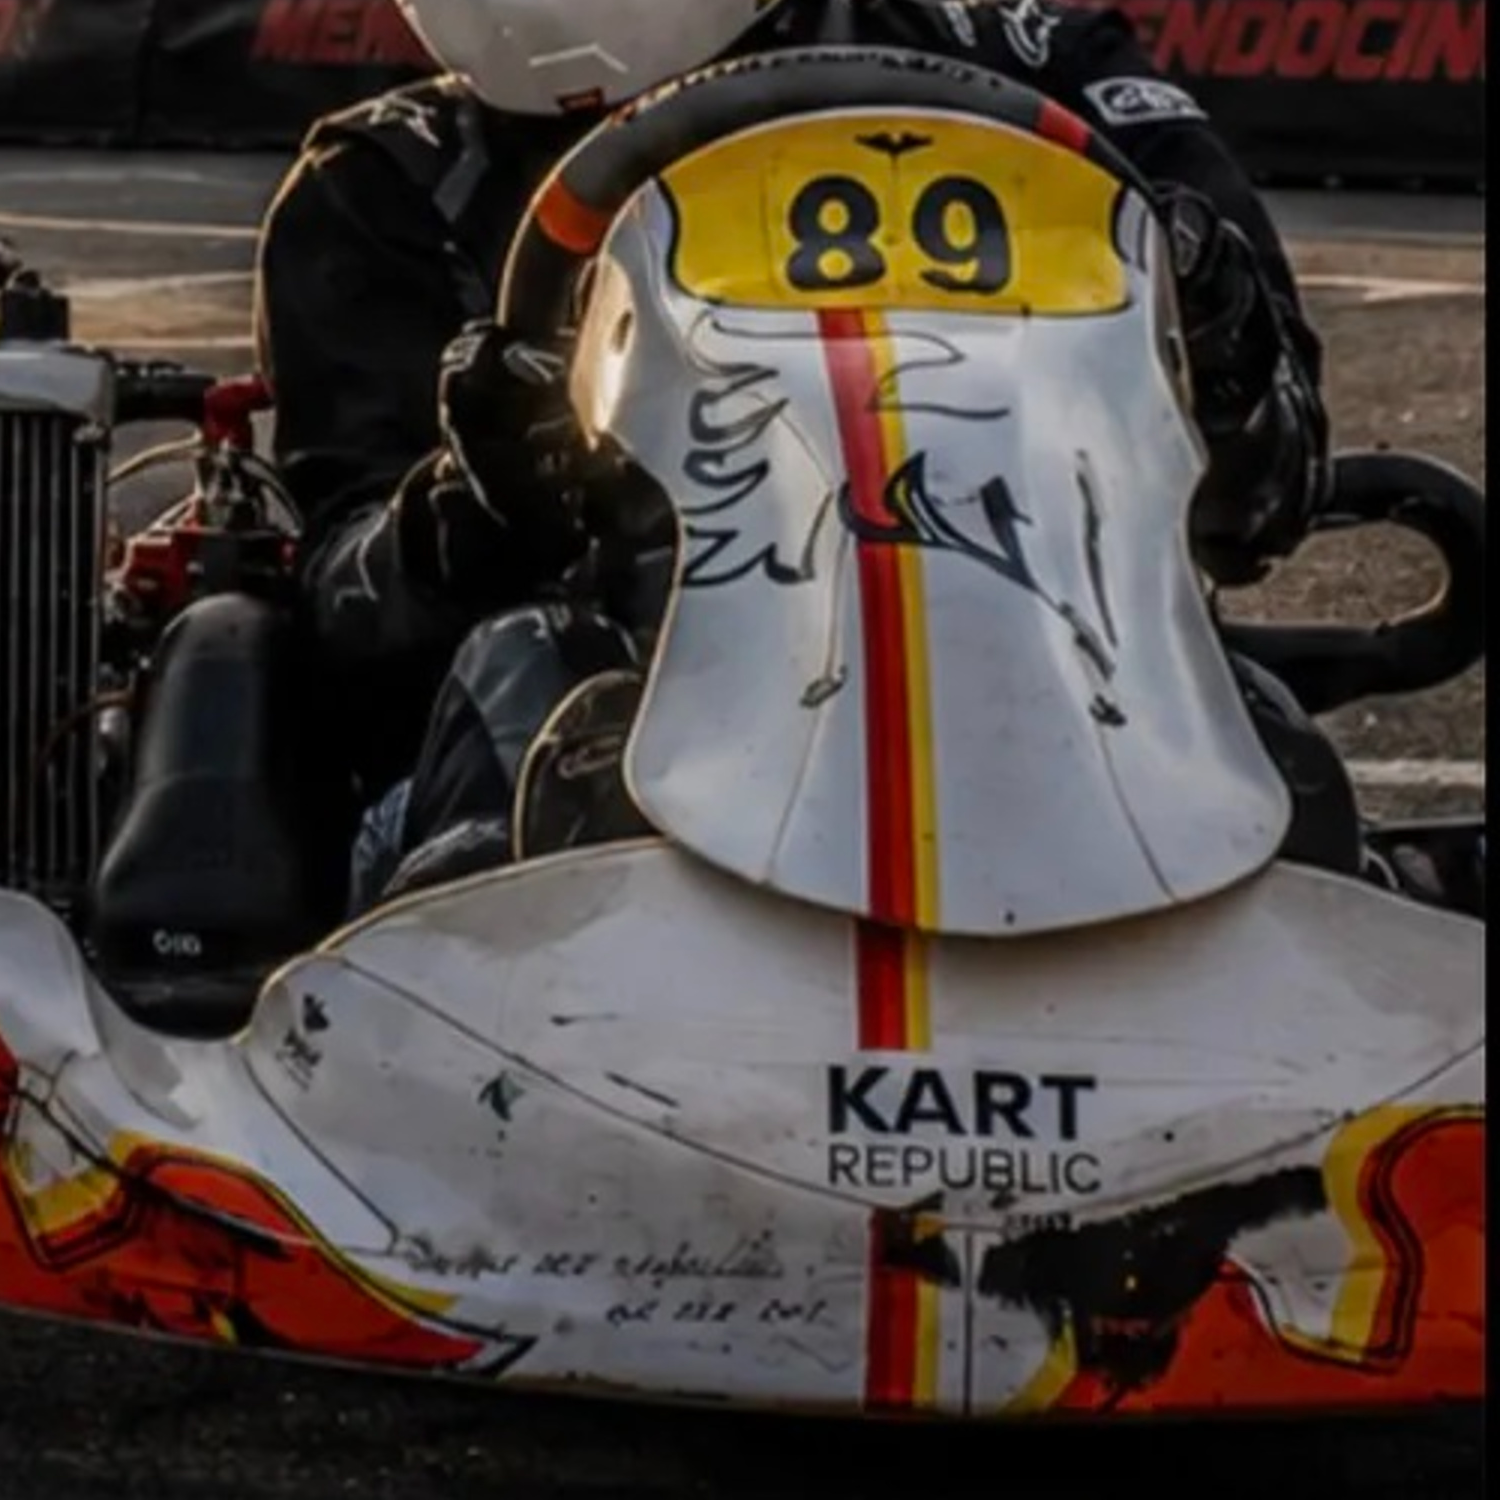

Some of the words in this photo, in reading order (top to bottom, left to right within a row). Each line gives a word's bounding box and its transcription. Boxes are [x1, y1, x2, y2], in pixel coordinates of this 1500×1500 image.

[785, 174, 1012, 293] 89
[827, 1065, 1097, 1141] KART
[827, 1142, 1102, 1195] REPUBLIC
